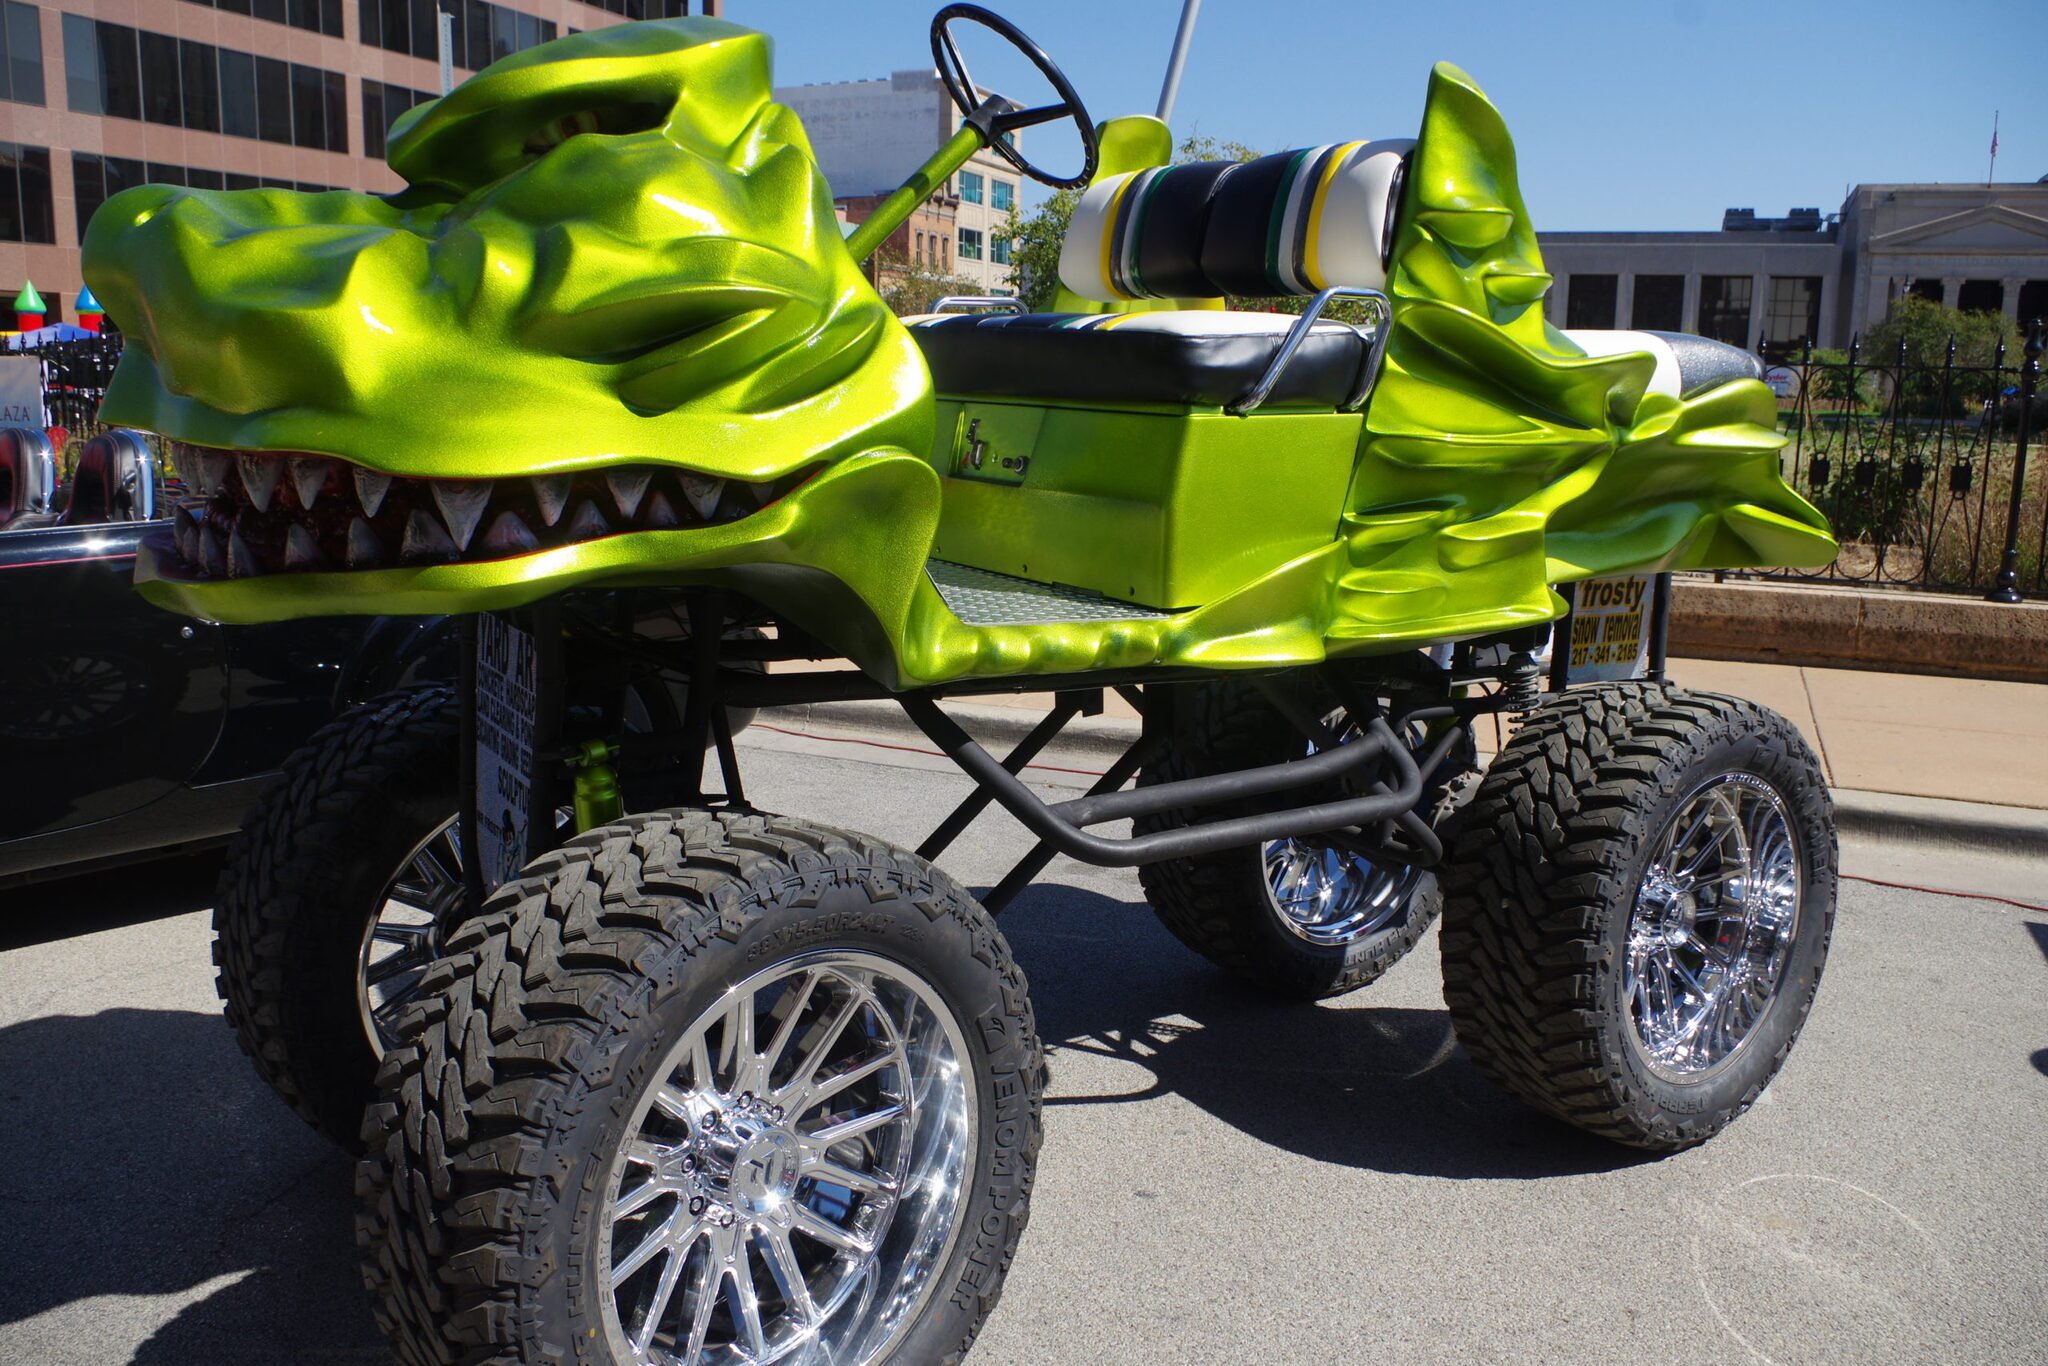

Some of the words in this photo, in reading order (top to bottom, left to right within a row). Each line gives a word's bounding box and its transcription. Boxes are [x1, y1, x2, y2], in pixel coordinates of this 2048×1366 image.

[0, 405, 30, 421] AZA
[1581, 576, 1647, 612] frosty
[1572, 616, 1601, 646] snow
[1603, 605, 1644, 643] removal
[480, 610, 509, 674] YARD
[515, 629, 537, 692] AR
[498, 765, 531, 815] SCULPTU
[991, 1063, 1017, 1178] VENOM
[950, 1185, 1008, 1312] POWER
